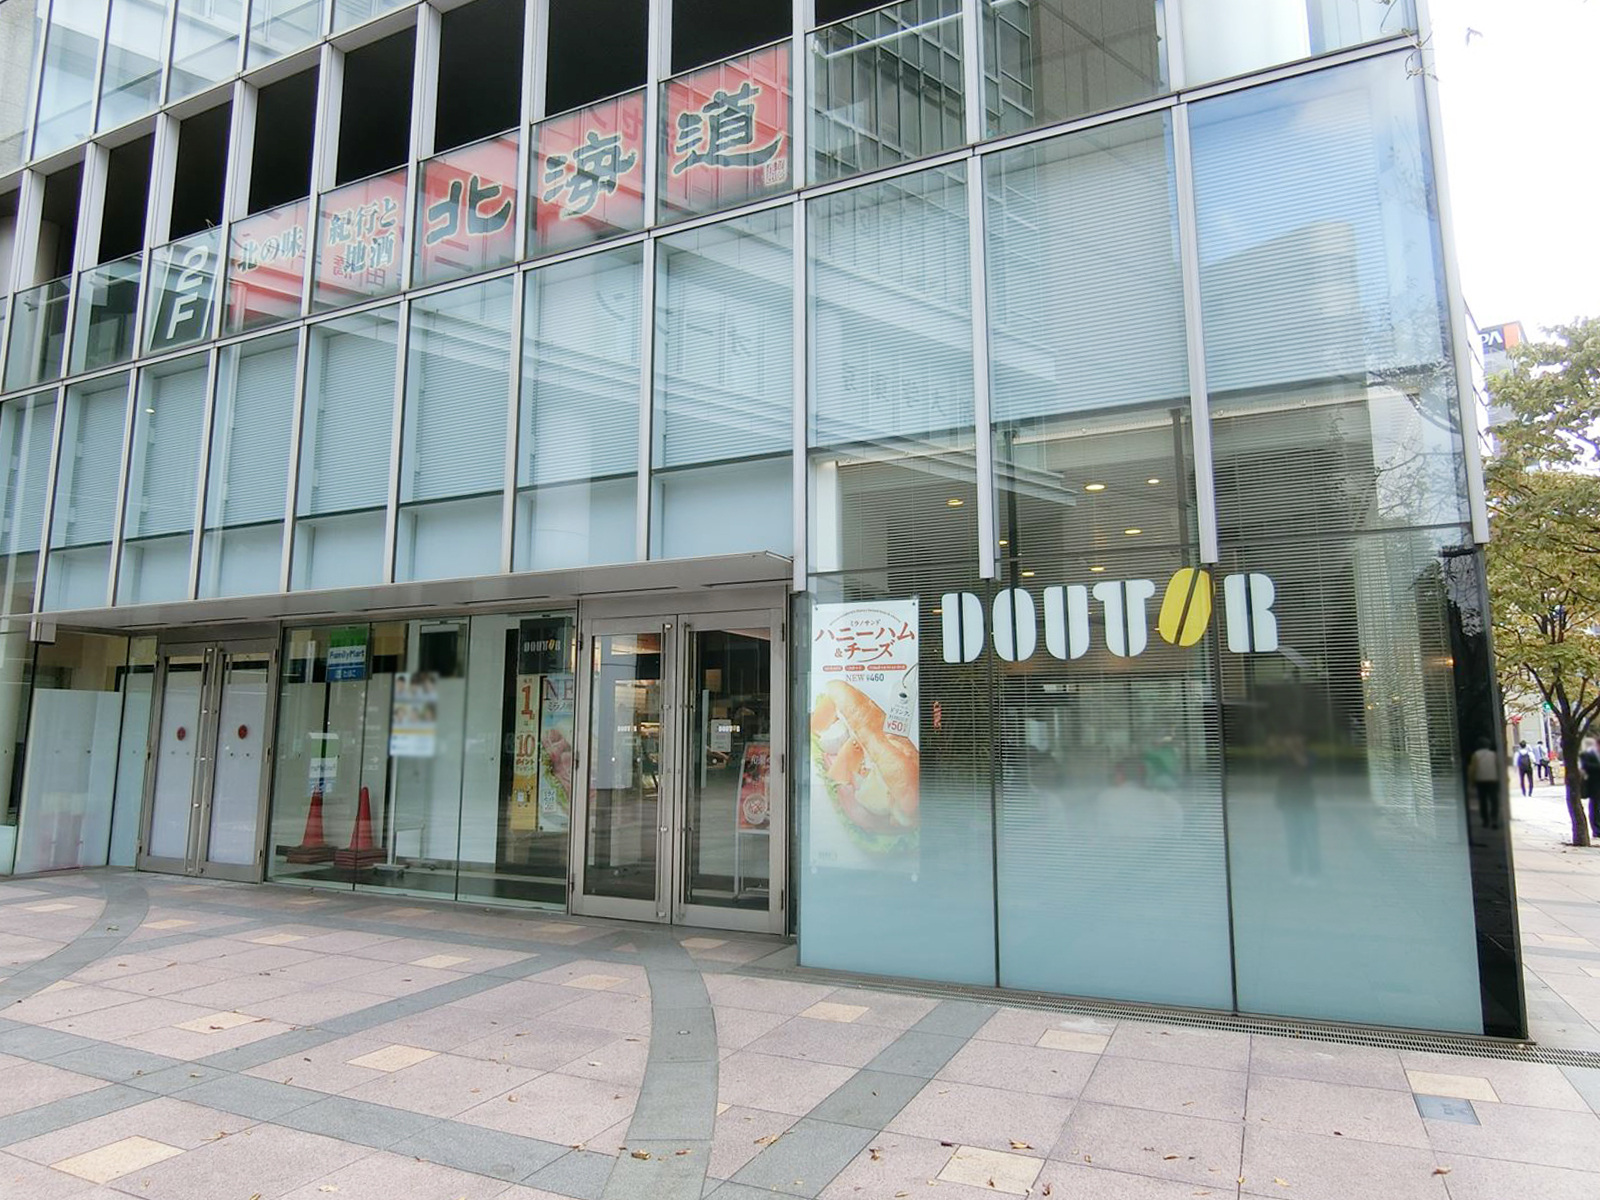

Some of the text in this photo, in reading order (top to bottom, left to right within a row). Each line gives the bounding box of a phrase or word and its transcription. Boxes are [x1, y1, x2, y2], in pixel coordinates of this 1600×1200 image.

[941, 567, 1279, 664] DOUTOR
[814, 621, 916, 642] ハニーハム
[845, 673, 865, 682] NEW
